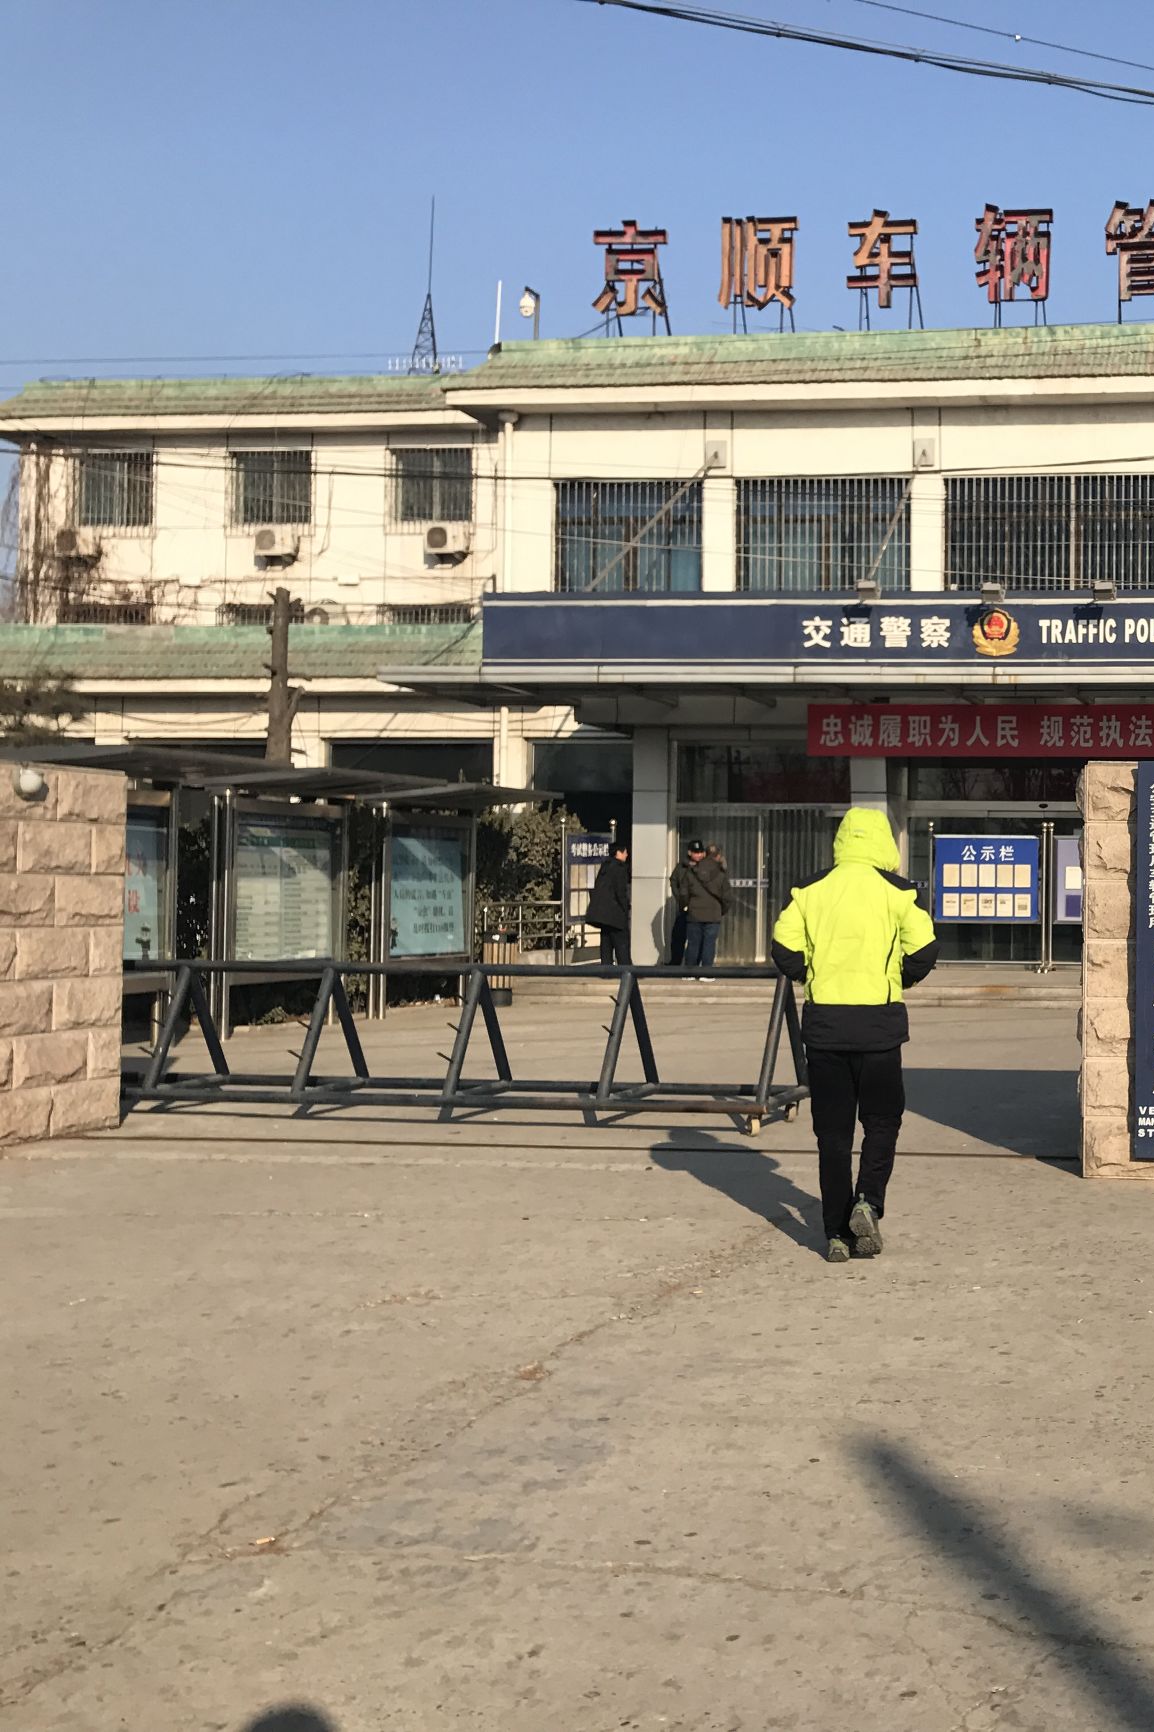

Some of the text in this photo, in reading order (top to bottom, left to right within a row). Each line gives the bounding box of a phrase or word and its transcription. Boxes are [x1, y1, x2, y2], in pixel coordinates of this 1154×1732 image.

[802, 616, 952, 648] 交通警察
[1039, 618, 1117, 644] TRAFFIC
[818, 714, 1020, 747] 忠诚履职为人民
[961, 844, 1015, 862] 公示栏
